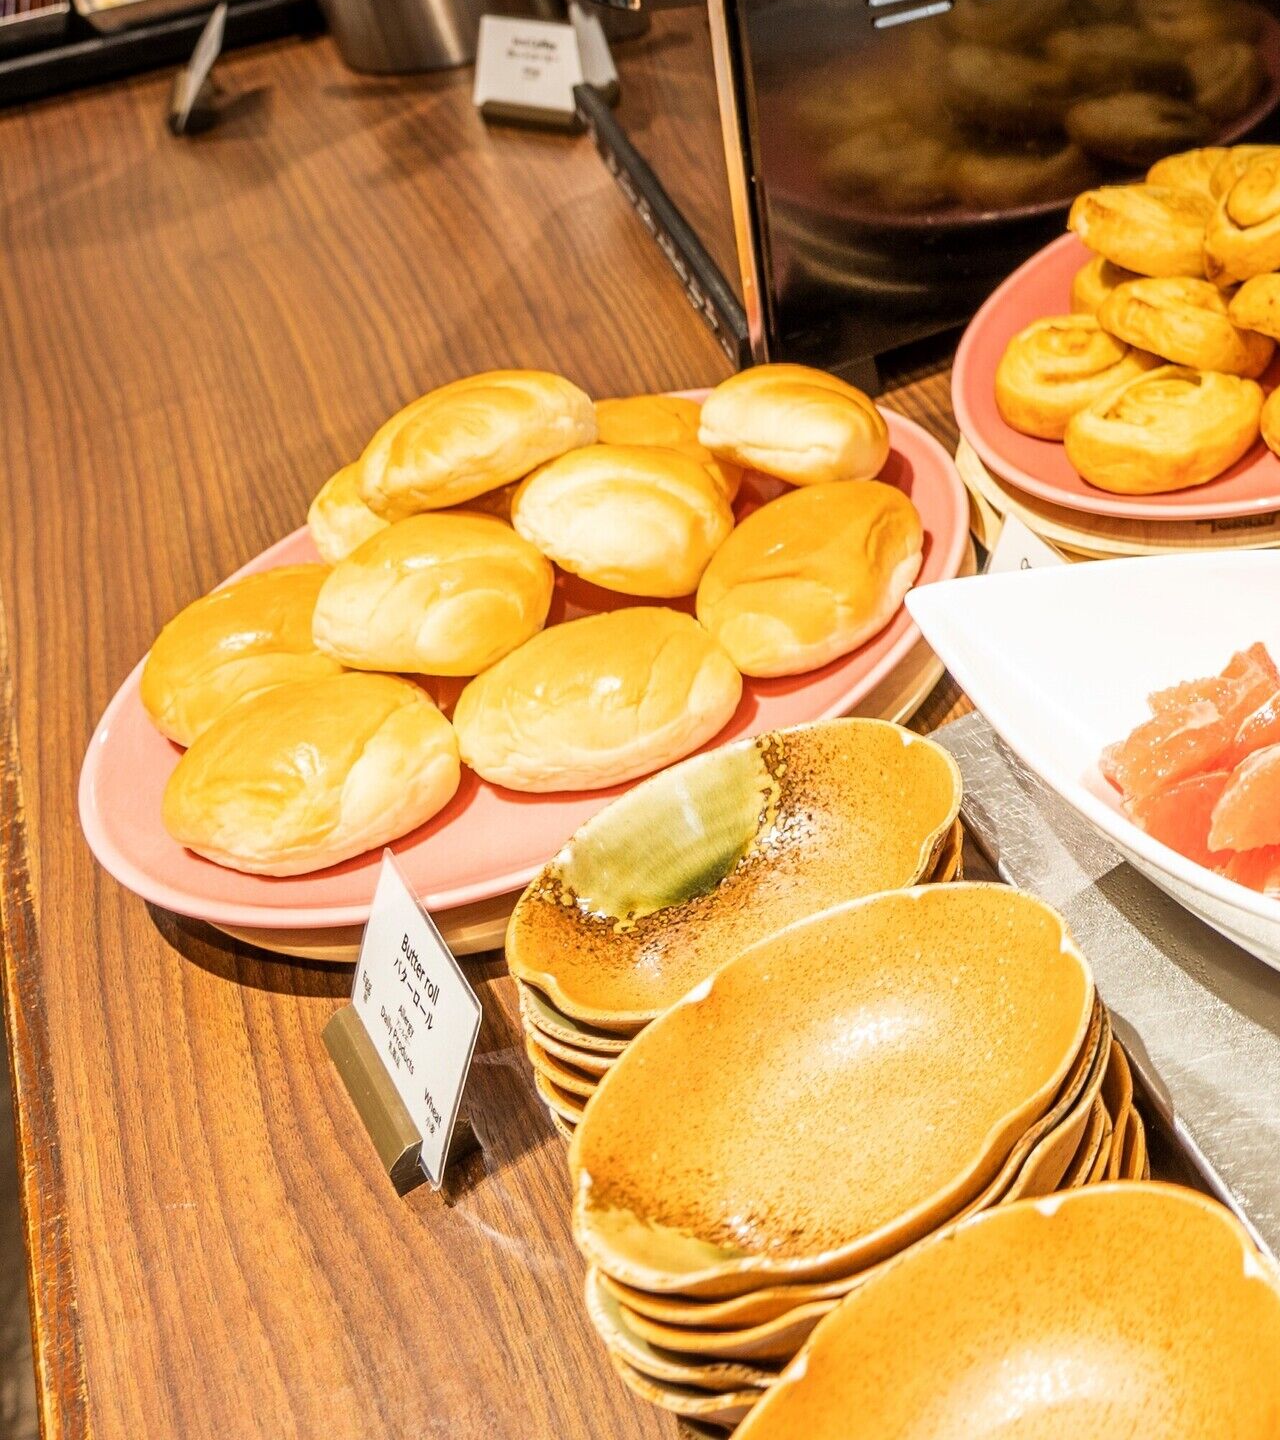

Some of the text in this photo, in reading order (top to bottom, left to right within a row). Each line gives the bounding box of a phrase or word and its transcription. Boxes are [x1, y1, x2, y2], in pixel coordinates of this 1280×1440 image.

[393, 957, 434, 1030] バターロール
[401, 932, 440, 1006] Butter roll
[424, 1087, 442, 1129] Wheat
